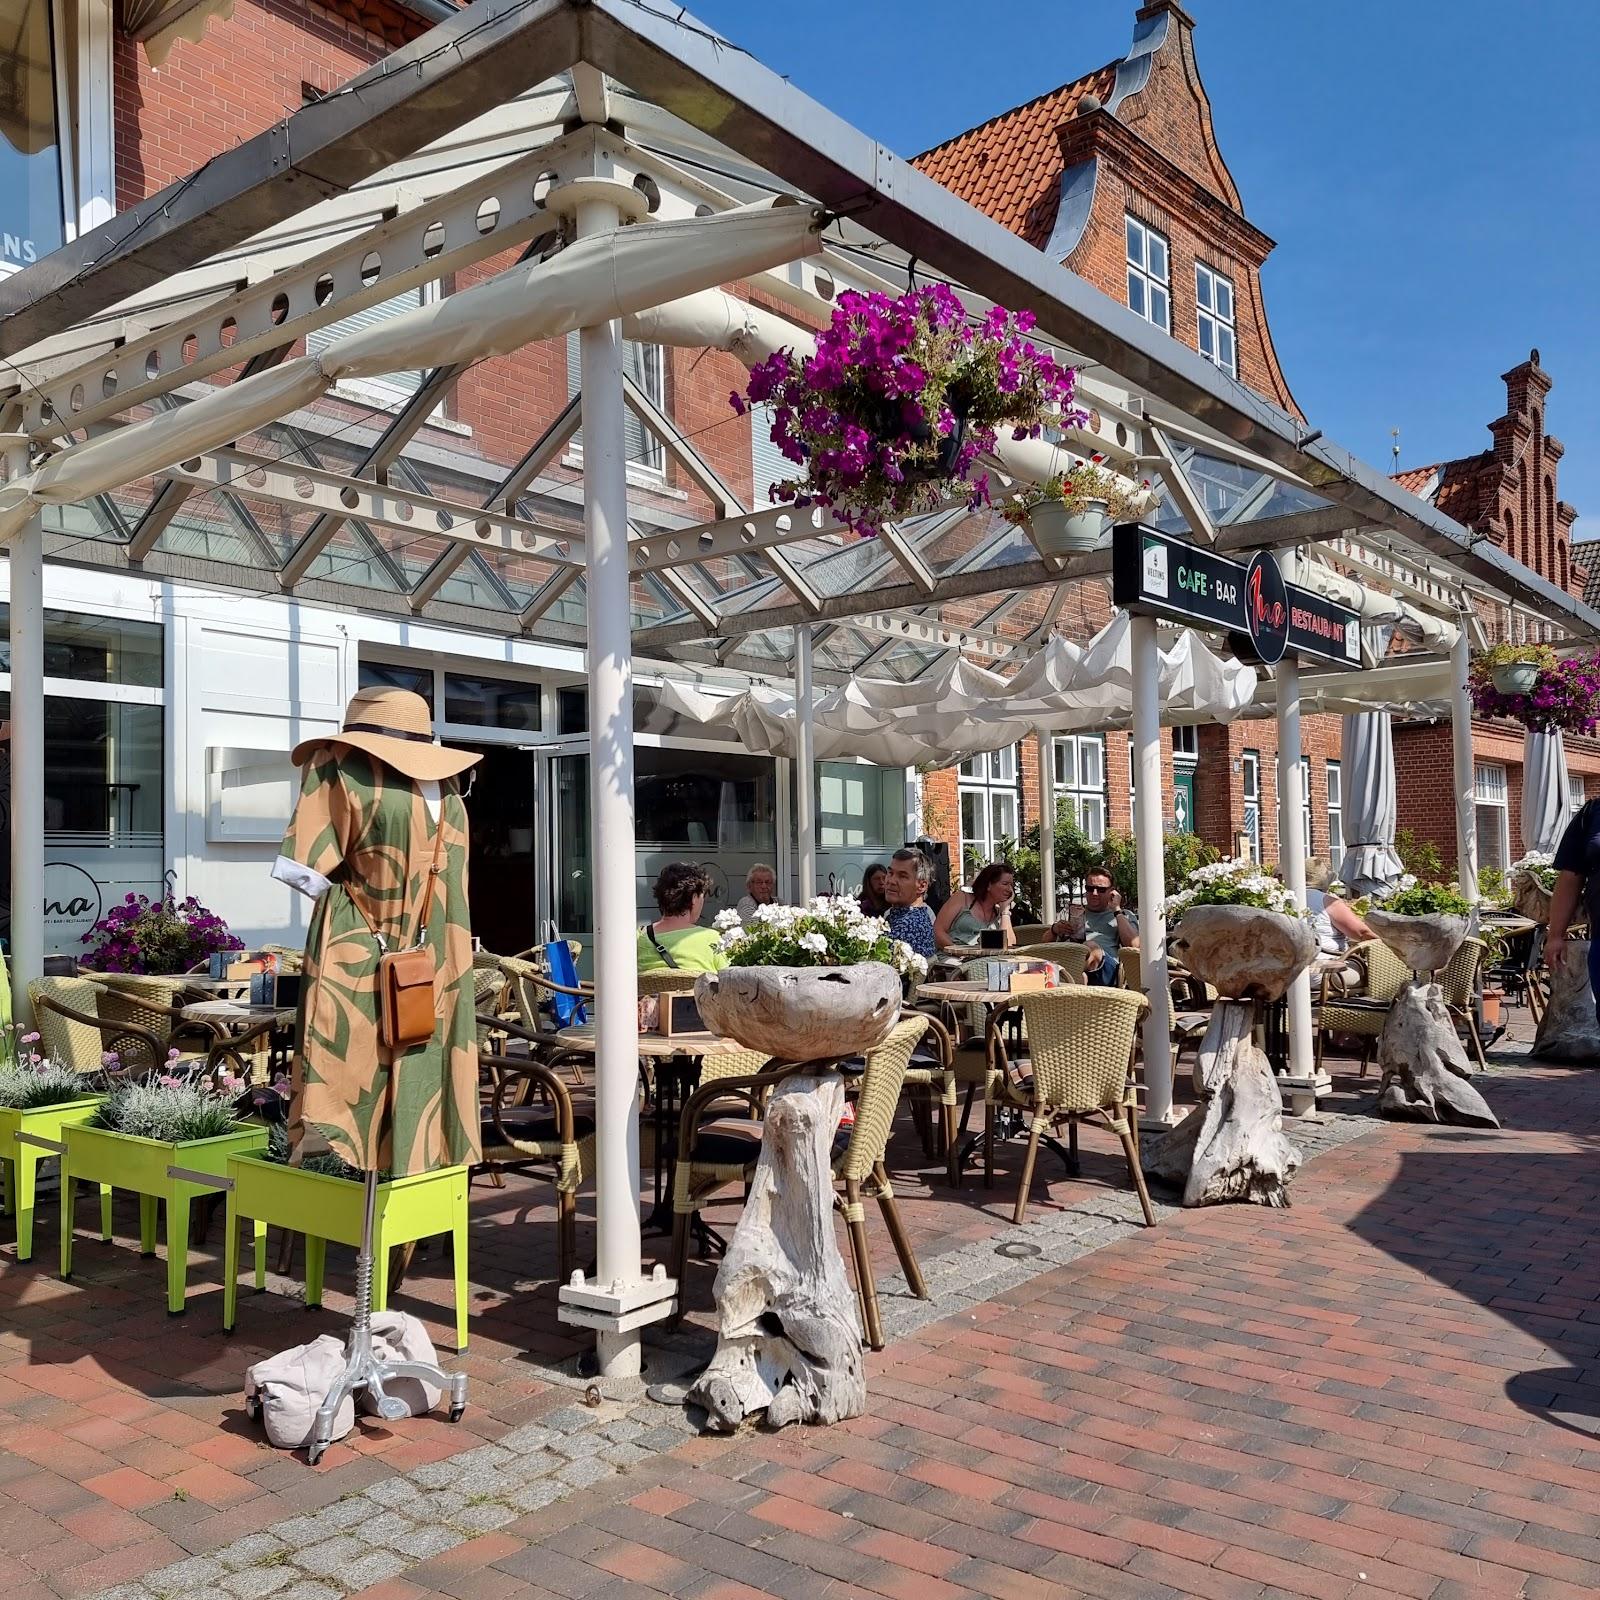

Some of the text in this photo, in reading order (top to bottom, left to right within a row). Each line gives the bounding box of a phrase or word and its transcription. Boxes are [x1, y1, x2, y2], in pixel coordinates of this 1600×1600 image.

[1177, 565, 1208, 597] CAFE
[1215, 579, 1237, 606] BAR
[44, 897, 95, 917] na
